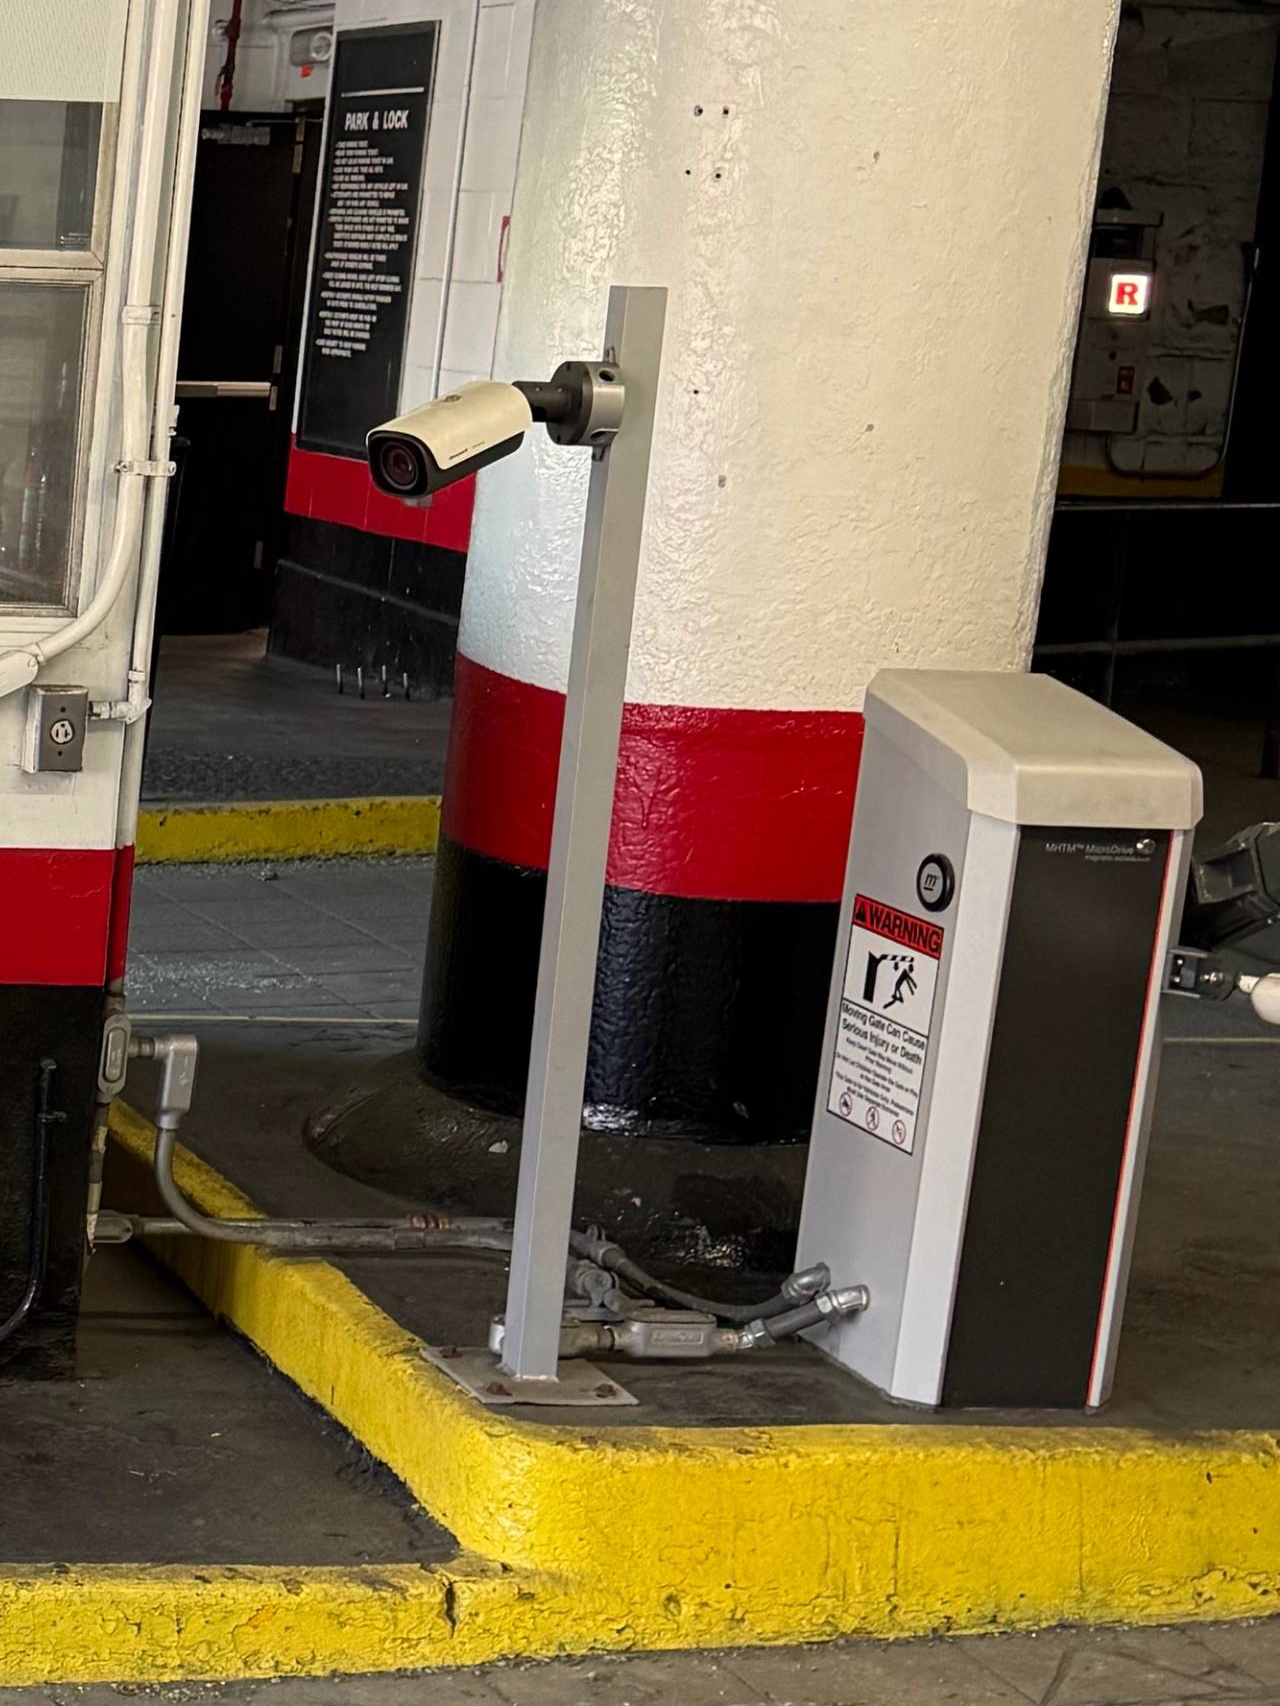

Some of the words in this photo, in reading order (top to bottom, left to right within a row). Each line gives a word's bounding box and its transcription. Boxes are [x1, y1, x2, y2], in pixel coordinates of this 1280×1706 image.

[344, 111, 370, 131] PARK
[372, 111, 380, 130] &
[383, 109, 409, 130] LOCK
[1116, 283, 1138, 305] R
[869, 902, 940, 954] WARNING
[842, 1002, 868, 1026] Moving
[868, 1015, 886, 1032] Gate
[886, 1023, 901, 1039] Can
[902, 1030, 925, 1050] Cause
[842, 1017, 868, 1040] Serious
[869, 1031, 889, 1053] Injury
[890, 1043, 899, 1054] or
[900, 1045, 922, 1065] Death
